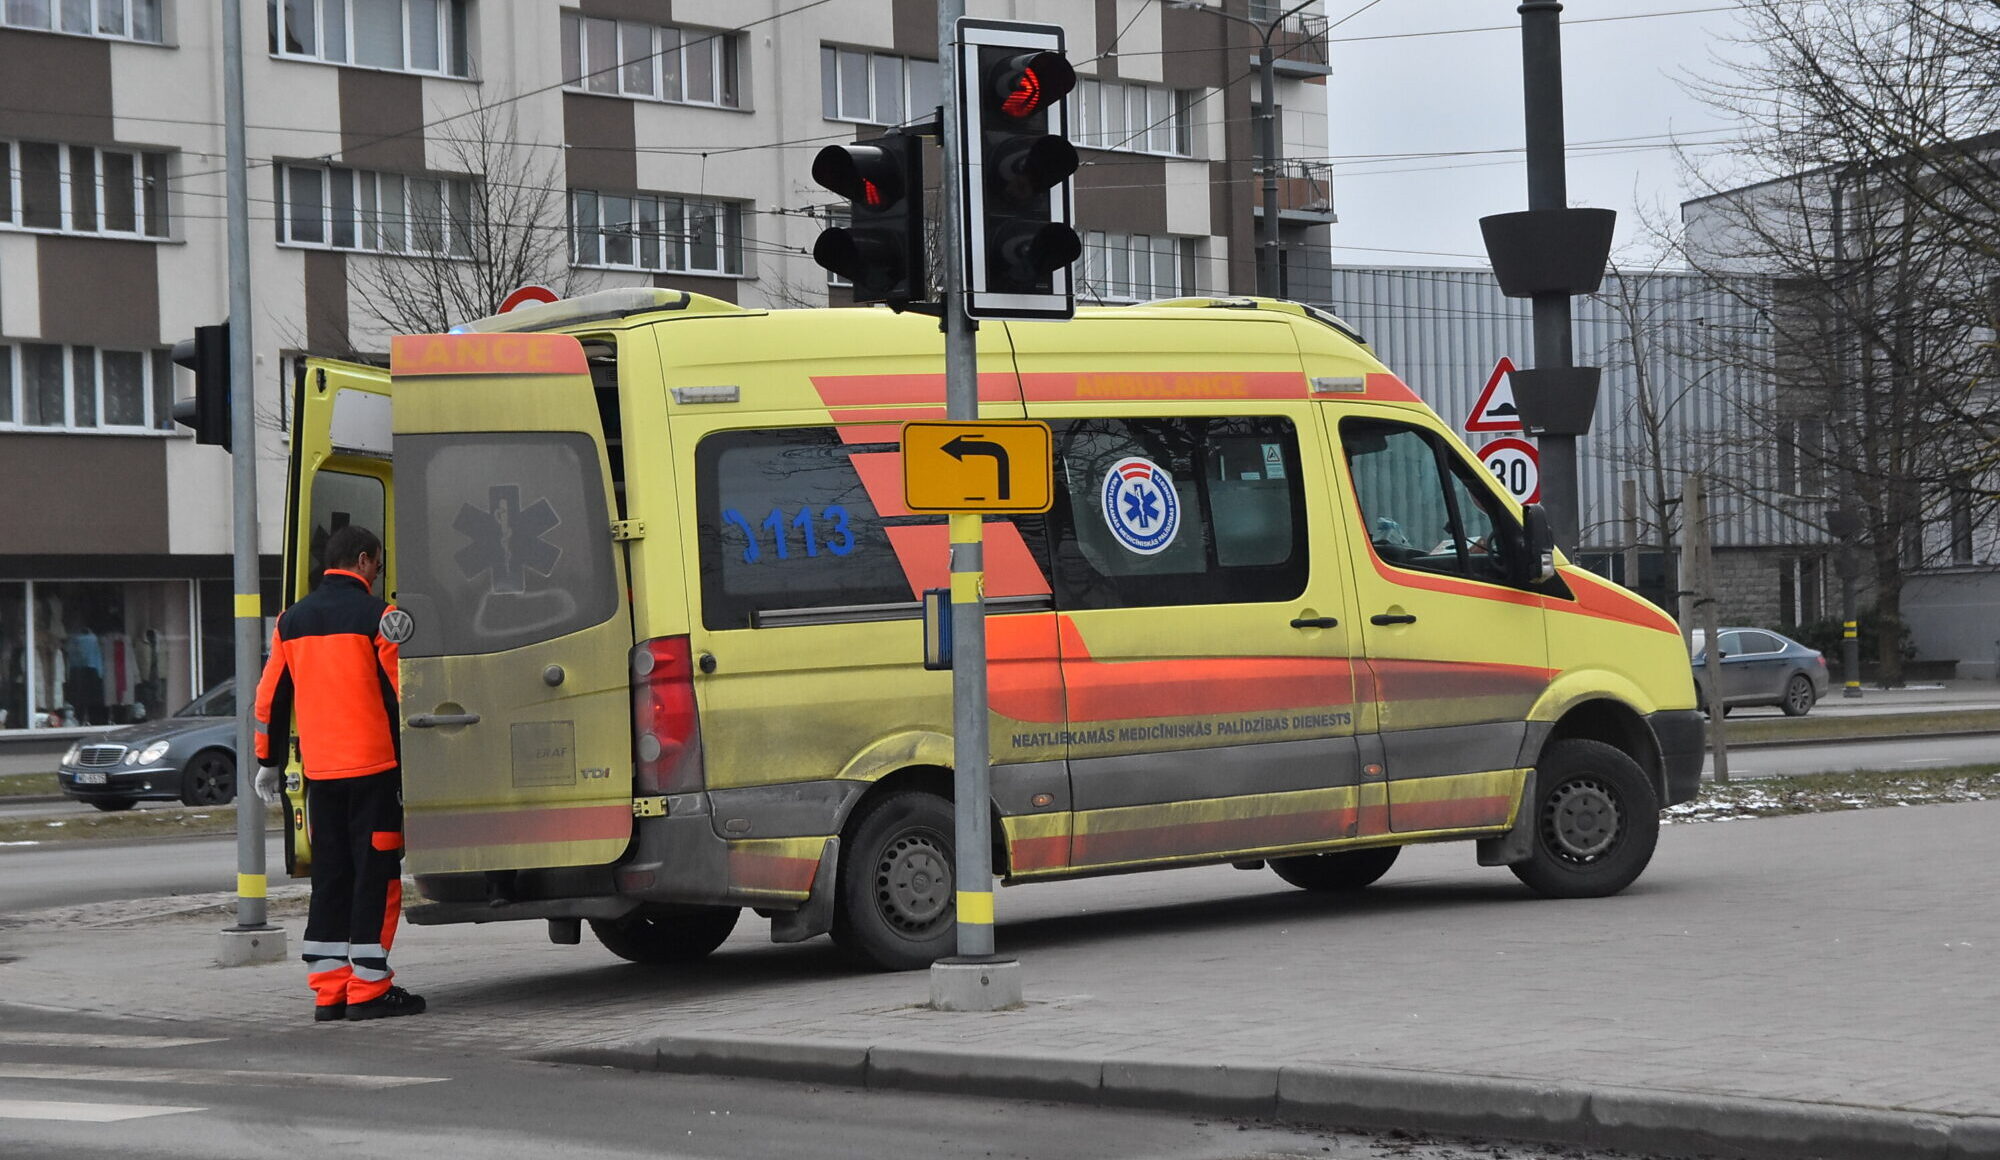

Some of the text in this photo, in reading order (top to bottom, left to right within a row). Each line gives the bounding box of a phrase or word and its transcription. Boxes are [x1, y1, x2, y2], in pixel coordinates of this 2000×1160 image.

[394, 339, 553, 368] LANCE
[1077, 375, 1248, 397] AMBULANCE
[1490, 458, 1527, 496] 30
[762, 504, 856, 560] 113
[1119, 722, 1212, 742] MEDICĪNISKĀS
[1217, 716, 1290, 735] PALĪDZĪBAS
[1292, 712, 1351, 729] DIENESTS
[580, 767, 610, 779] TDI
